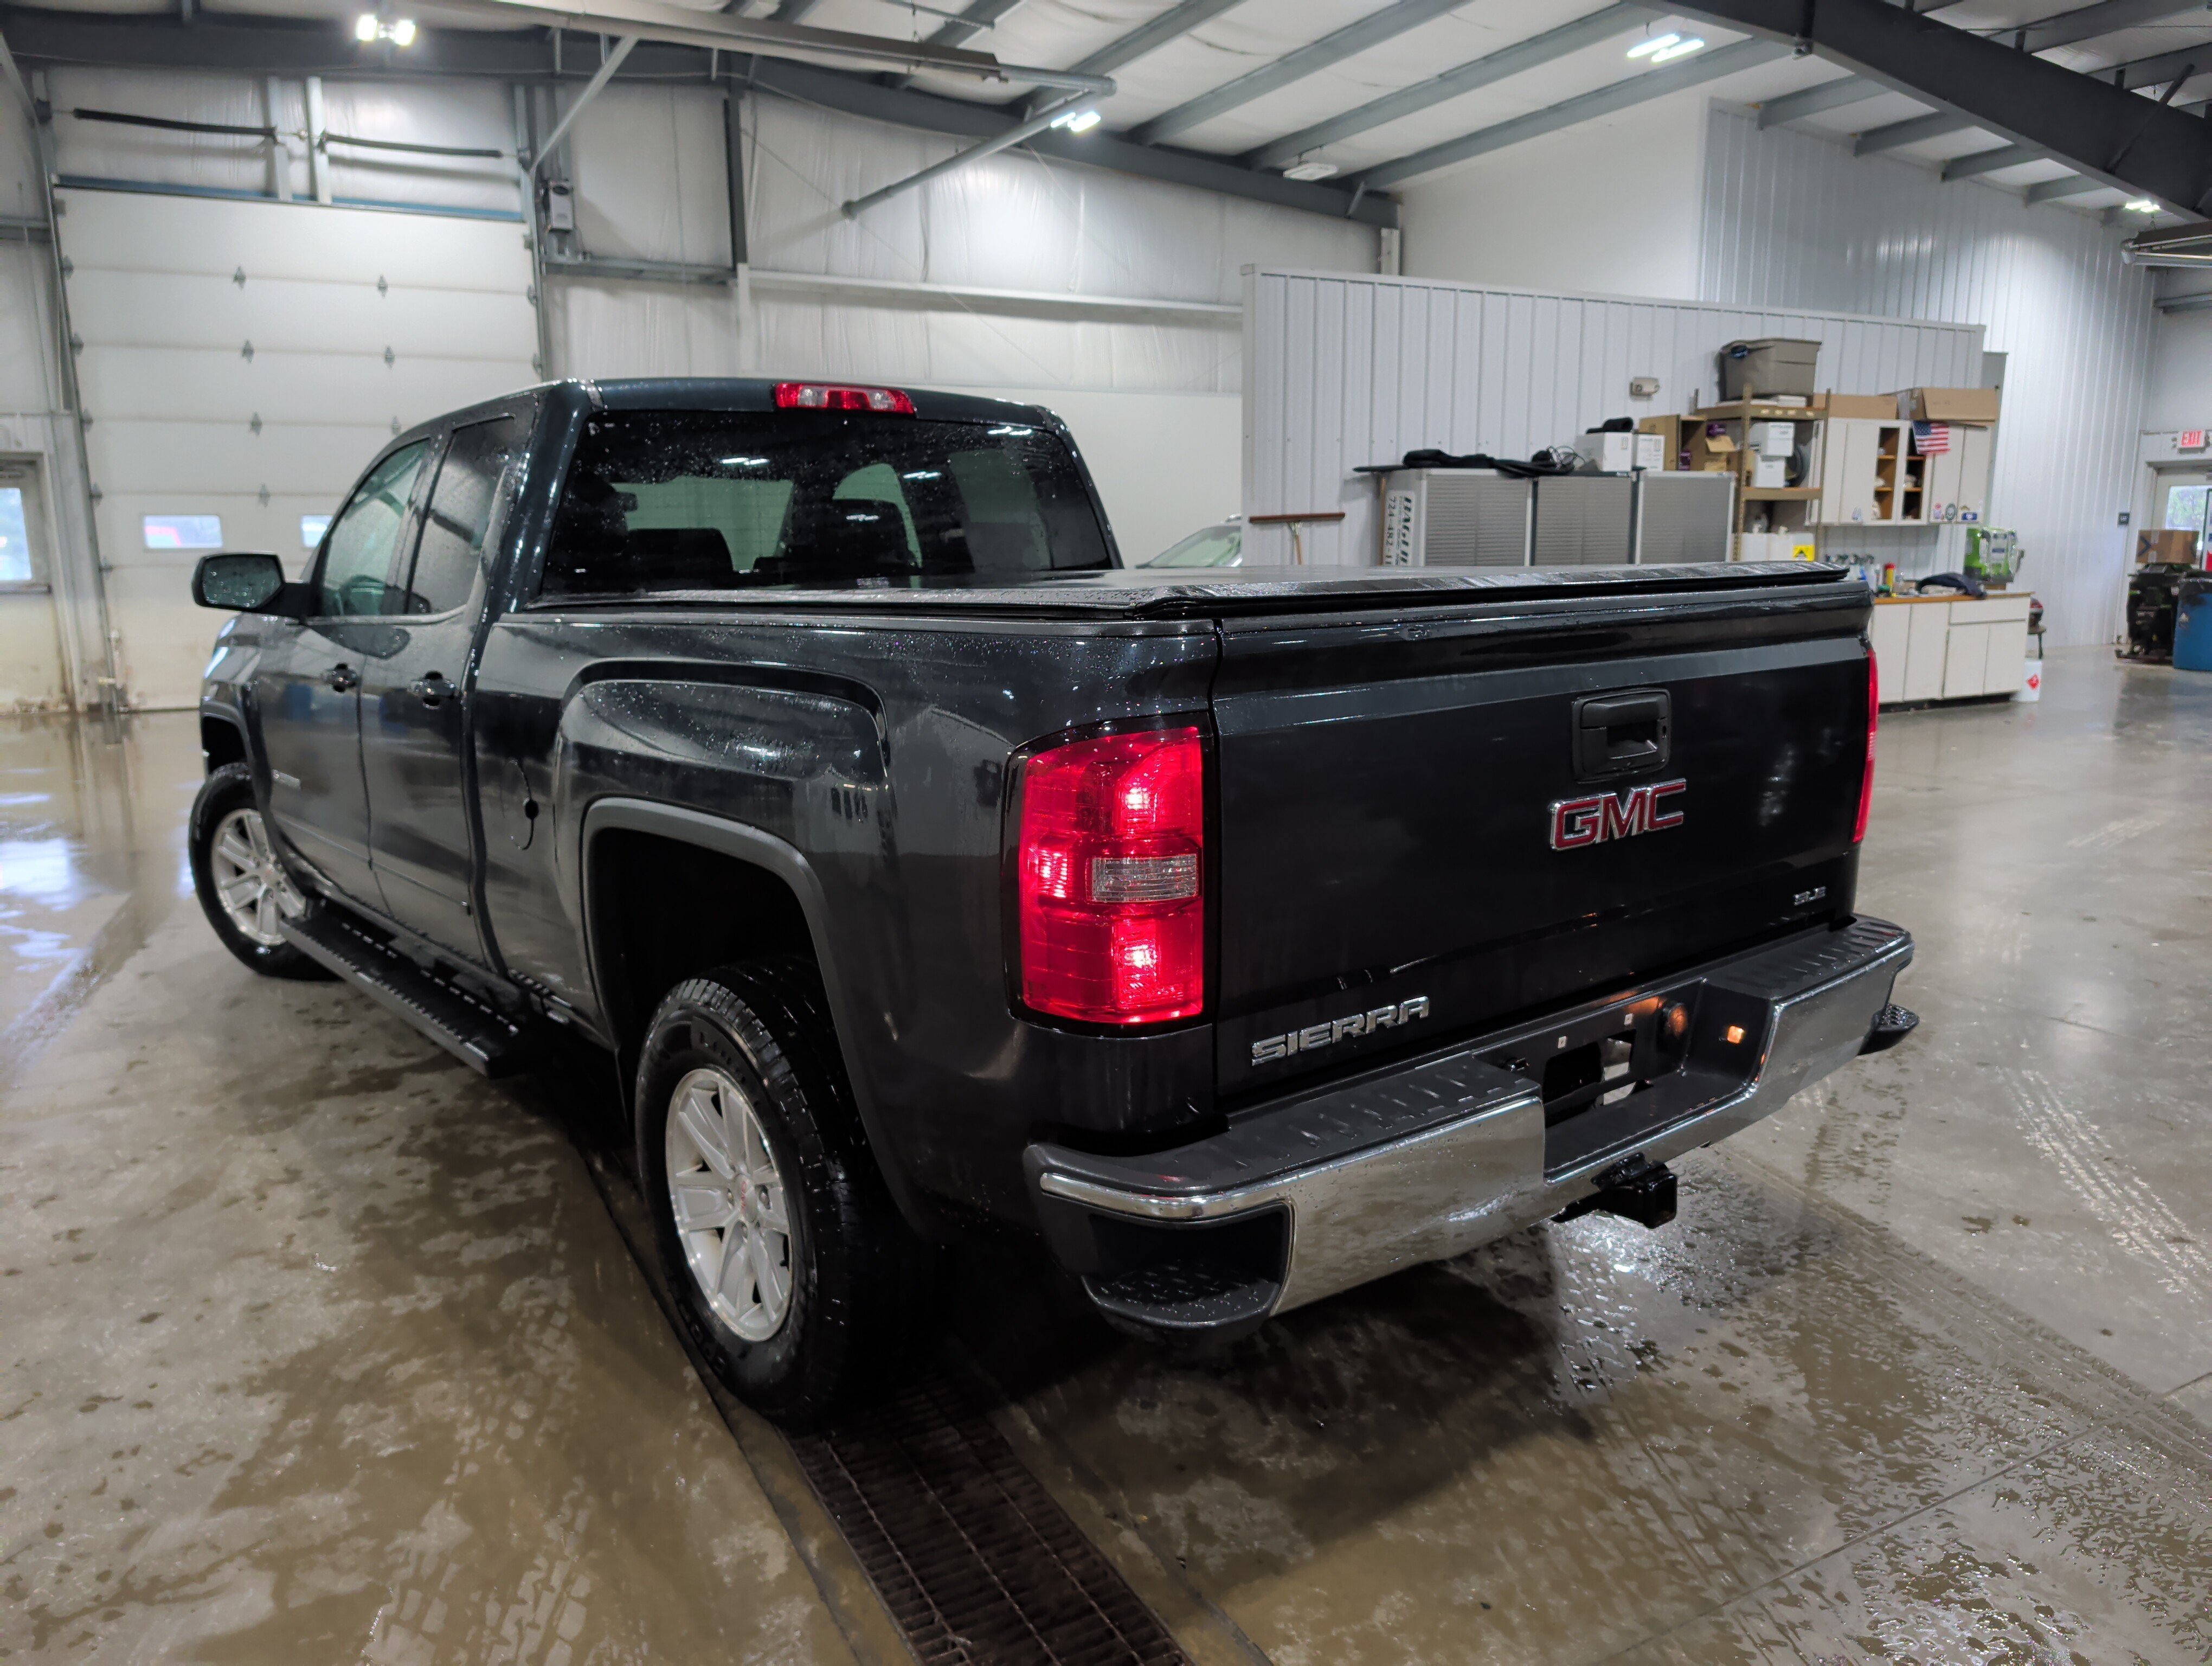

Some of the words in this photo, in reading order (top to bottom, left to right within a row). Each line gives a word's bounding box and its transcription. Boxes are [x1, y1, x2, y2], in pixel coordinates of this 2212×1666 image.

[2182, 430, 2202, 447] EXIT
[1548, 778, 1687, 851] GMC
[1251, 996, 1430, 1066] SIERRA
